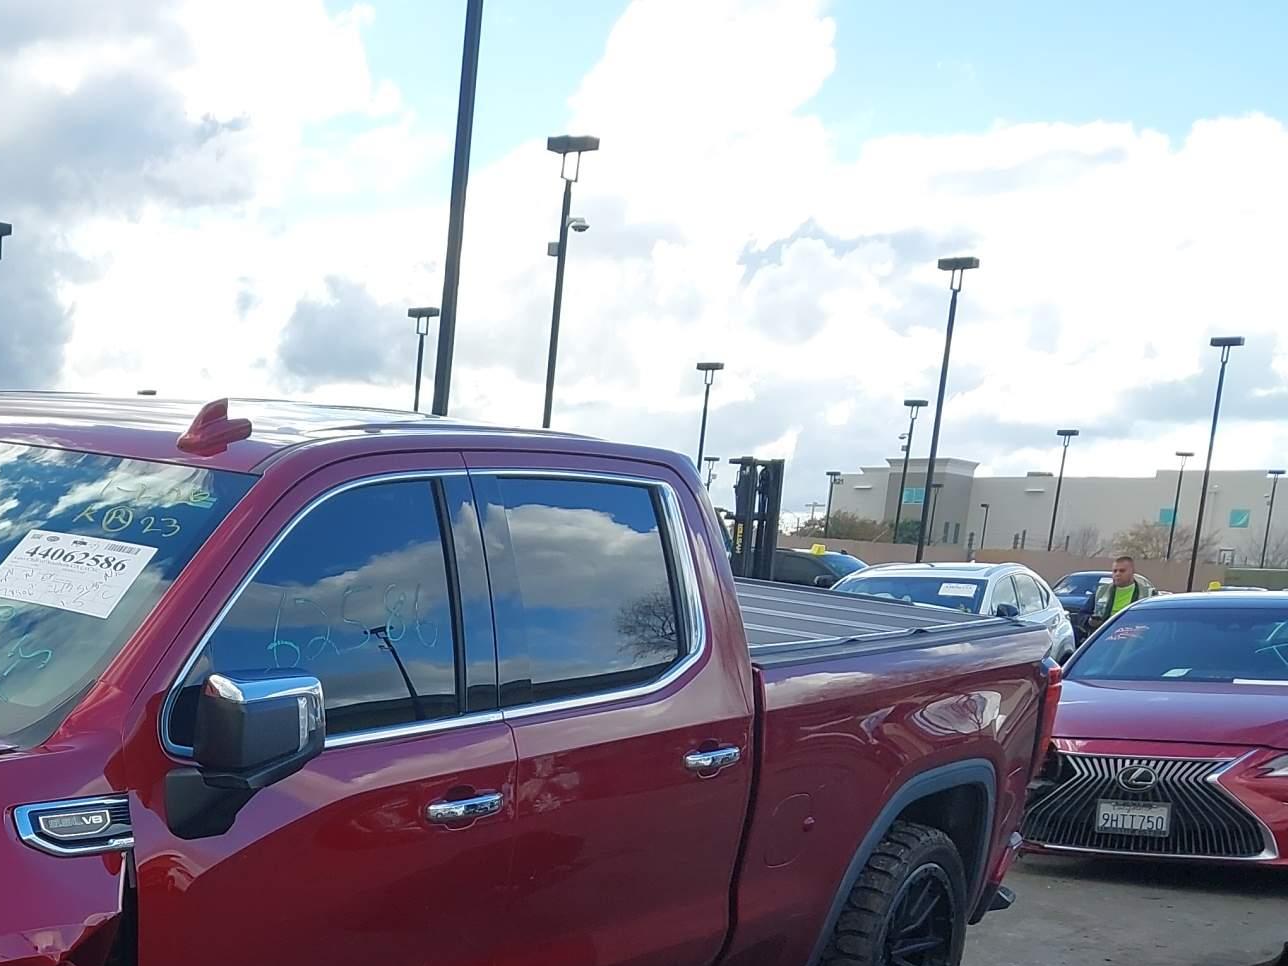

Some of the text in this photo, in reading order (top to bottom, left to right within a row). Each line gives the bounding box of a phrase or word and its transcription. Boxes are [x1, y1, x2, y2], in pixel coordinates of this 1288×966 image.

[140, 516, 181, 537] 23
[25, 544, 130, 572] 44062586
[1102, 812, 1164, 831] 9HTT750
